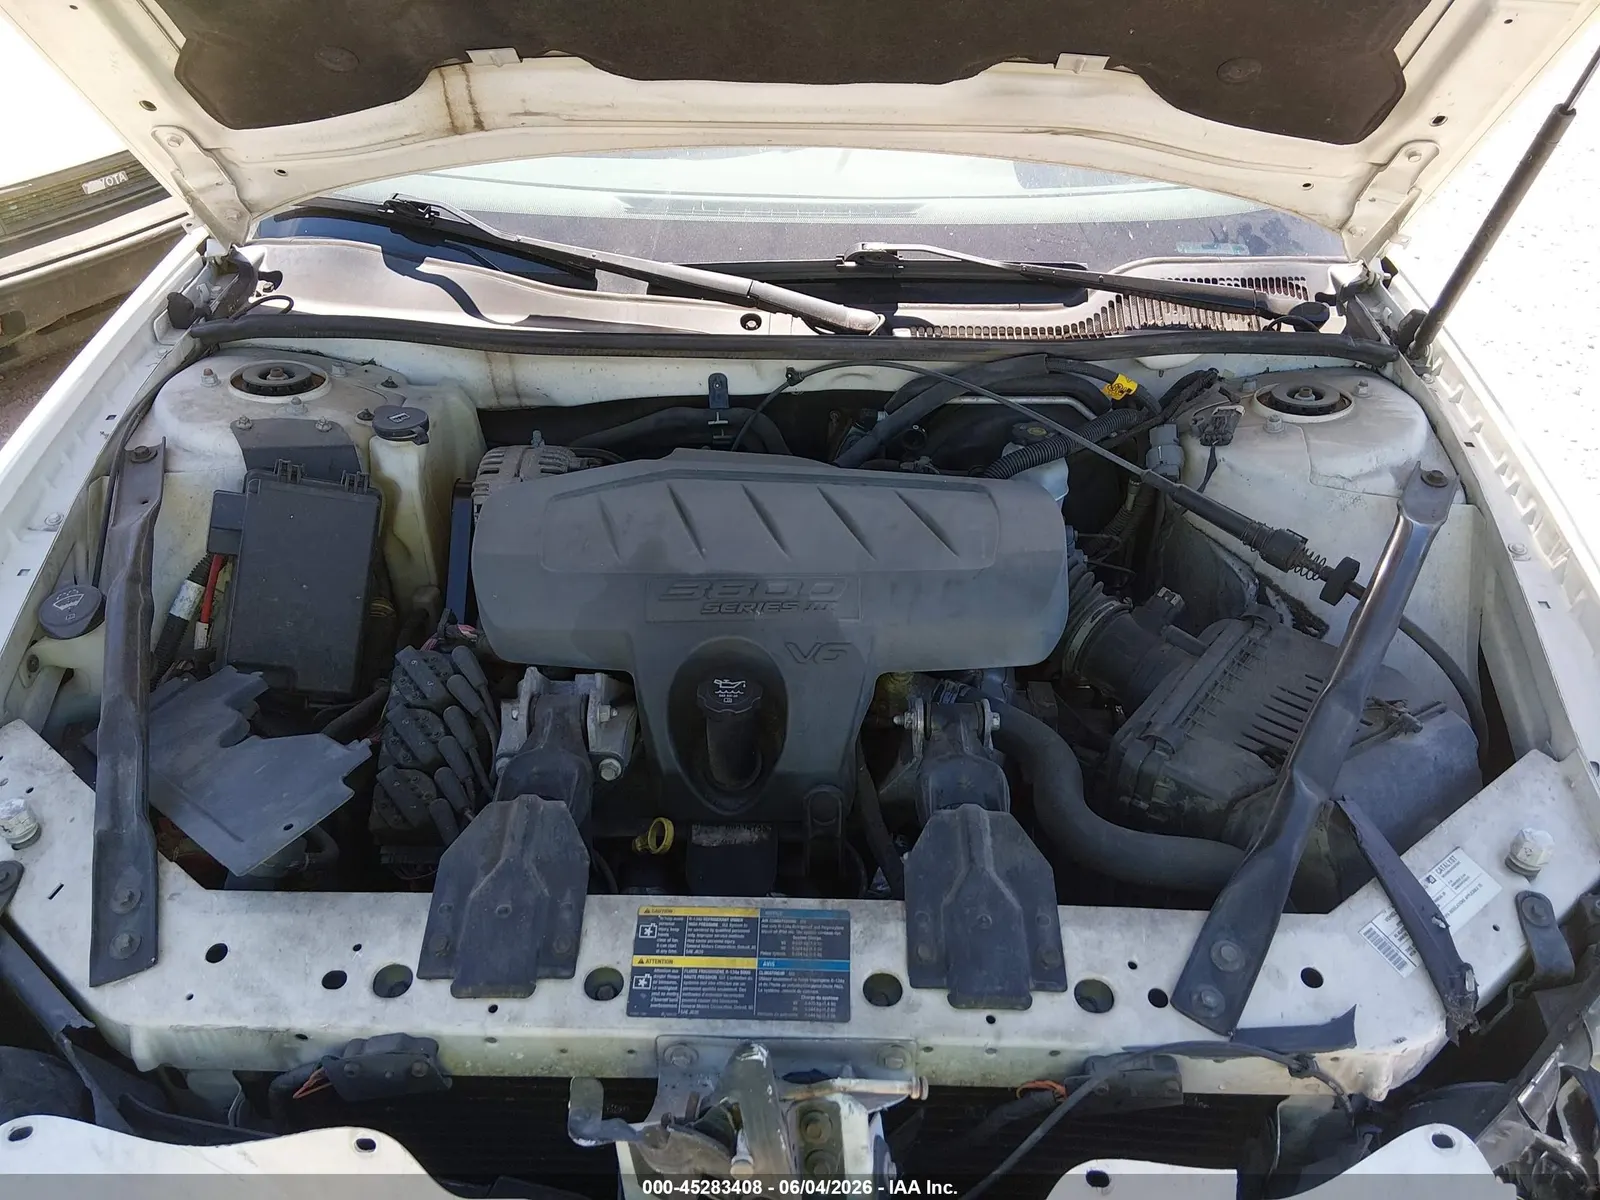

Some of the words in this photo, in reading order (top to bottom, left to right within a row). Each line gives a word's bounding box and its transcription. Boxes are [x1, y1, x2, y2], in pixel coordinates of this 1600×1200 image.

[659, 579, 848, 601] 3800
[701, 601, 800, 615] SERIES
[785, 642, 852, 665] V6
